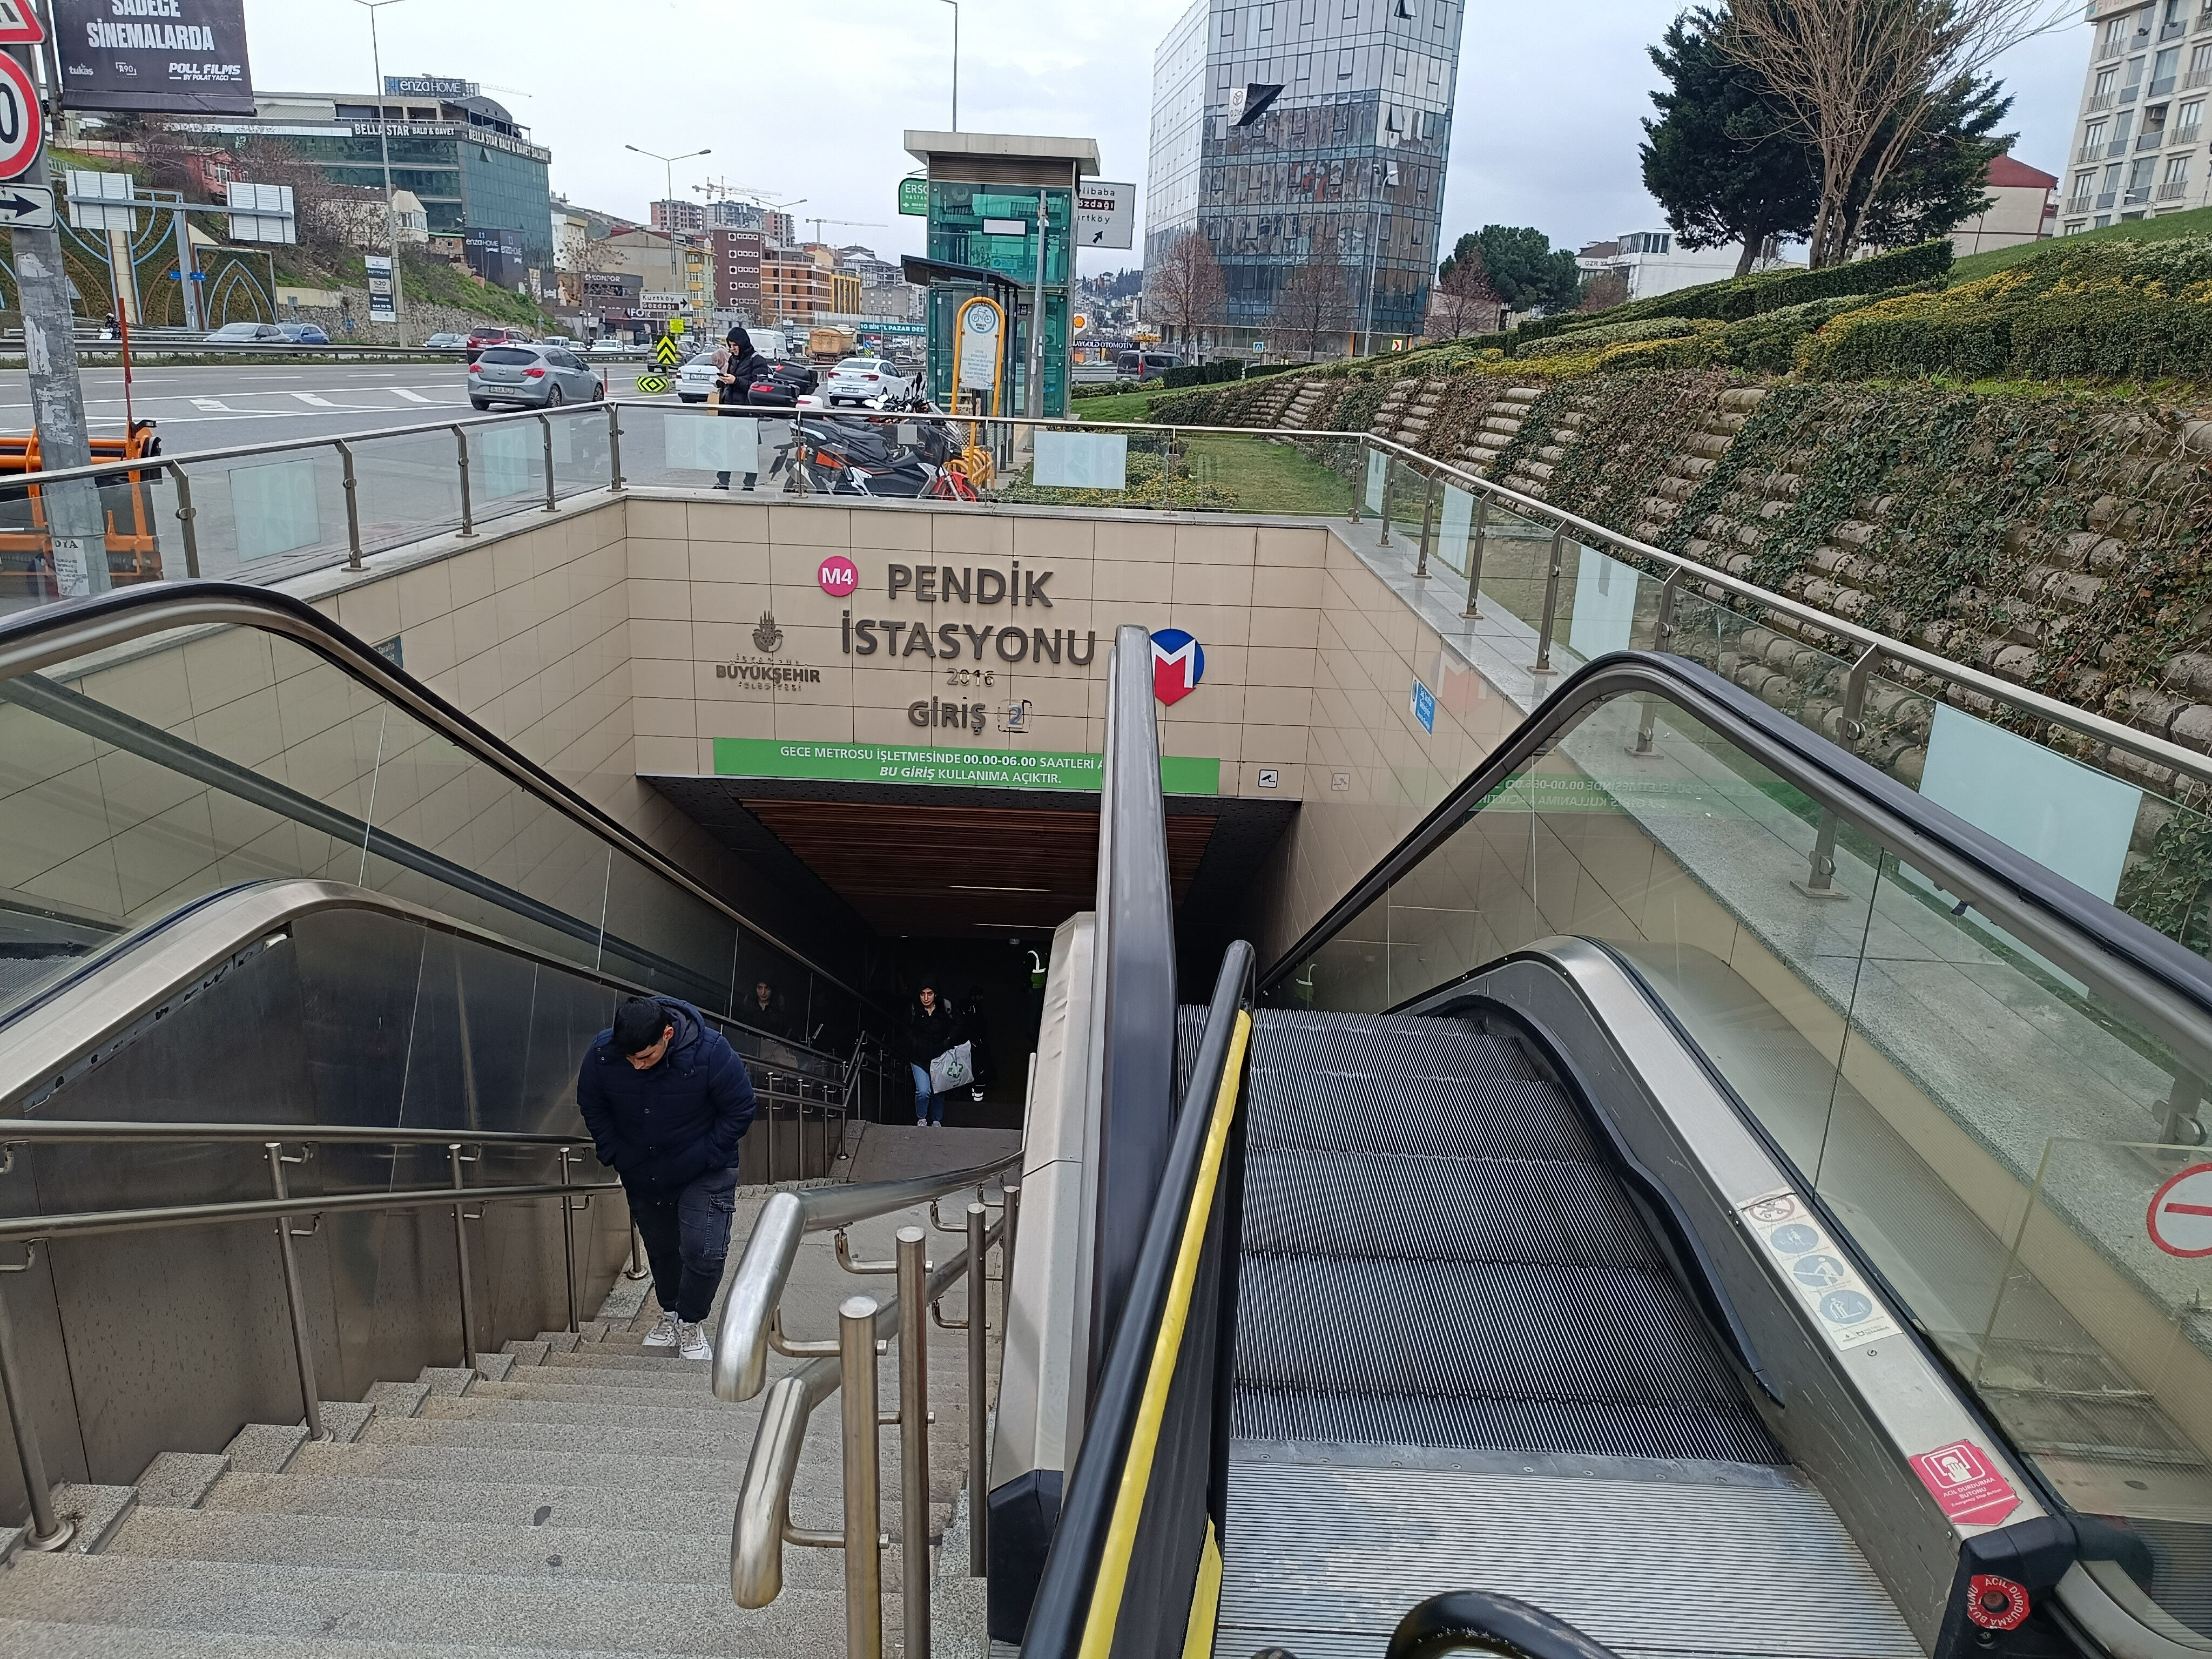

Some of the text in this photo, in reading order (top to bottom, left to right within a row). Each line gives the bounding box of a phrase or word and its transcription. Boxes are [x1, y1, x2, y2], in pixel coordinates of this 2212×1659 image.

[112, 0, 181, 17] SADECE
[86, 18, 215, 51] SİNEMALARDA
[168, 63, 241, 75] POLL FILMS
[400, 80, 461, 93] enza HOME
[354, 124, 382, 136] BELLA
[386, 124, 410, 136] STAR
[412, 127, 428, 136] BALO
[435, 127, 455, 136] DAVET
[468, 129, 485, 144] BELLA
[485, 133, 498, 147] STAR
[822, 567, 854, 585] M4
[888, 560, 1054, 608] PENDİK
[842, 609, 1096, 665] İSTASYONU
[716, 660, 821, 684] BÜYÜKŞEHİR
[947, 667, 995, 687] 2016
[908, 695, 1023, 736] GİRİŞ 2
[780, 746, 811, 757] GECE
[814, 747, 873, 760] METROSU
[876, 748, 961, 764] İŞLETMESİNDE
[963, 754, 1037, 767] 00.00-06.00
[1040, 757, 1094, 770] SAATLERİ
[879, 765, 1062, 785] BU GİRİŞ KULLANIMA AÇIKTIR.
[1943, 1477, 1996, 1498] ACİL DURDURMA
[1959, 1486, 1987, 1499] BUTONU
[1990, 1586, 2024, 1627] DURDURMA
